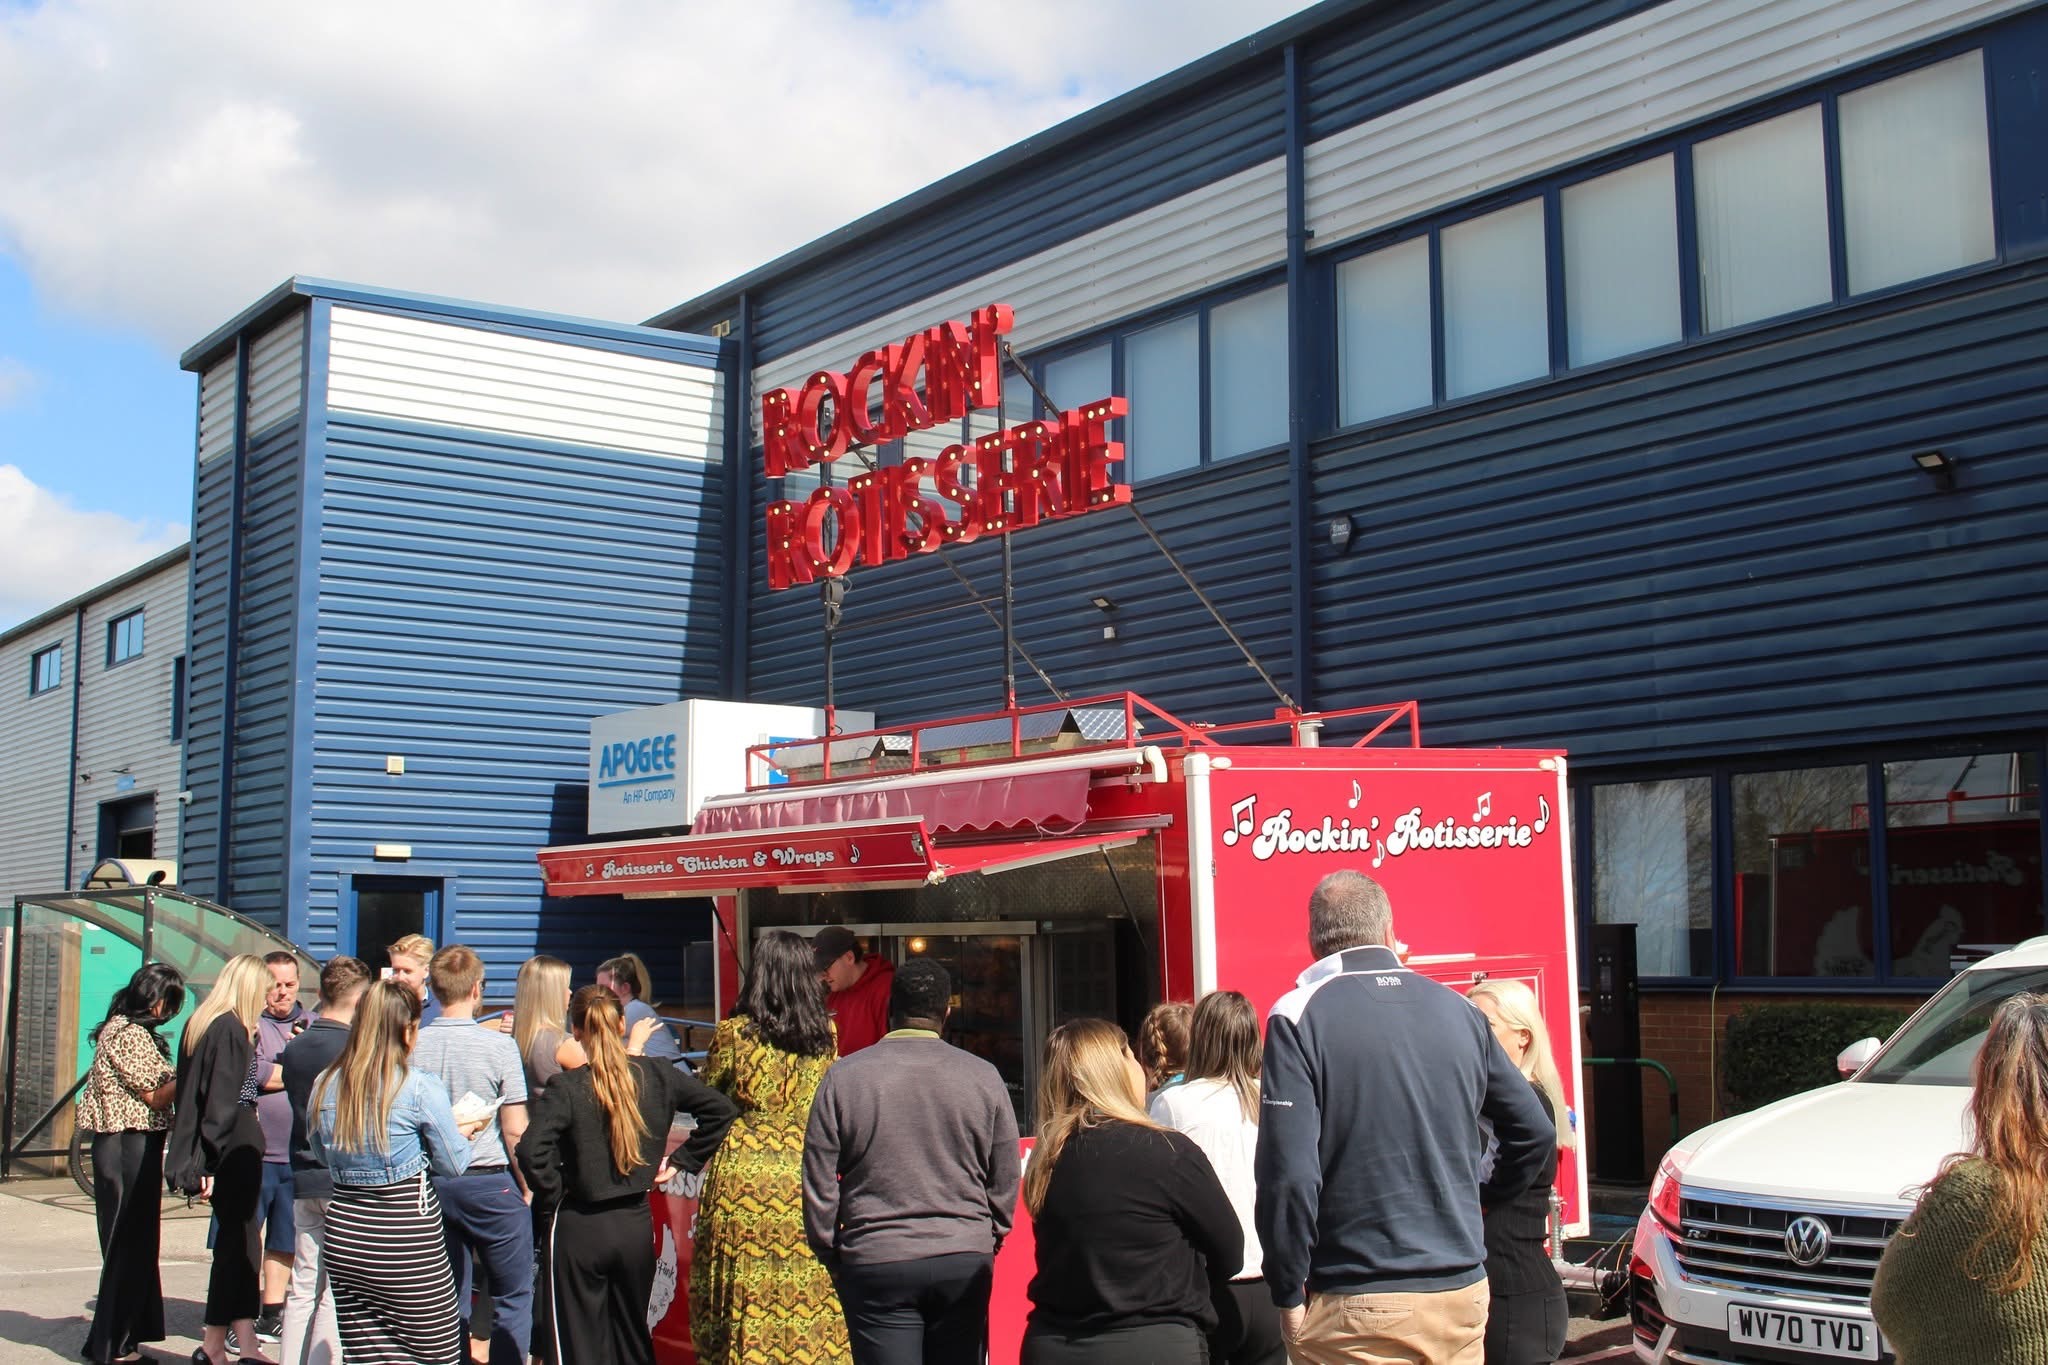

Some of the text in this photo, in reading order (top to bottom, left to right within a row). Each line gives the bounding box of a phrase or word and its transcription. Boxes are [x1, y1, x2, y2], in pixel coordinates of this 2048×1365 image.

[766, 396, 1133, 590] ROTISSERIE
[598, 733, 676, 779] APOGEE
[623, 787, 675, 804] An HP Company
[1252, 806, 1533, 860] Rockin' Rotisserie
[601, 847, 835, 880] Rotisserie Chicken & Wraps
[1738, 1309, 1863, 1352] WV70 TVD
